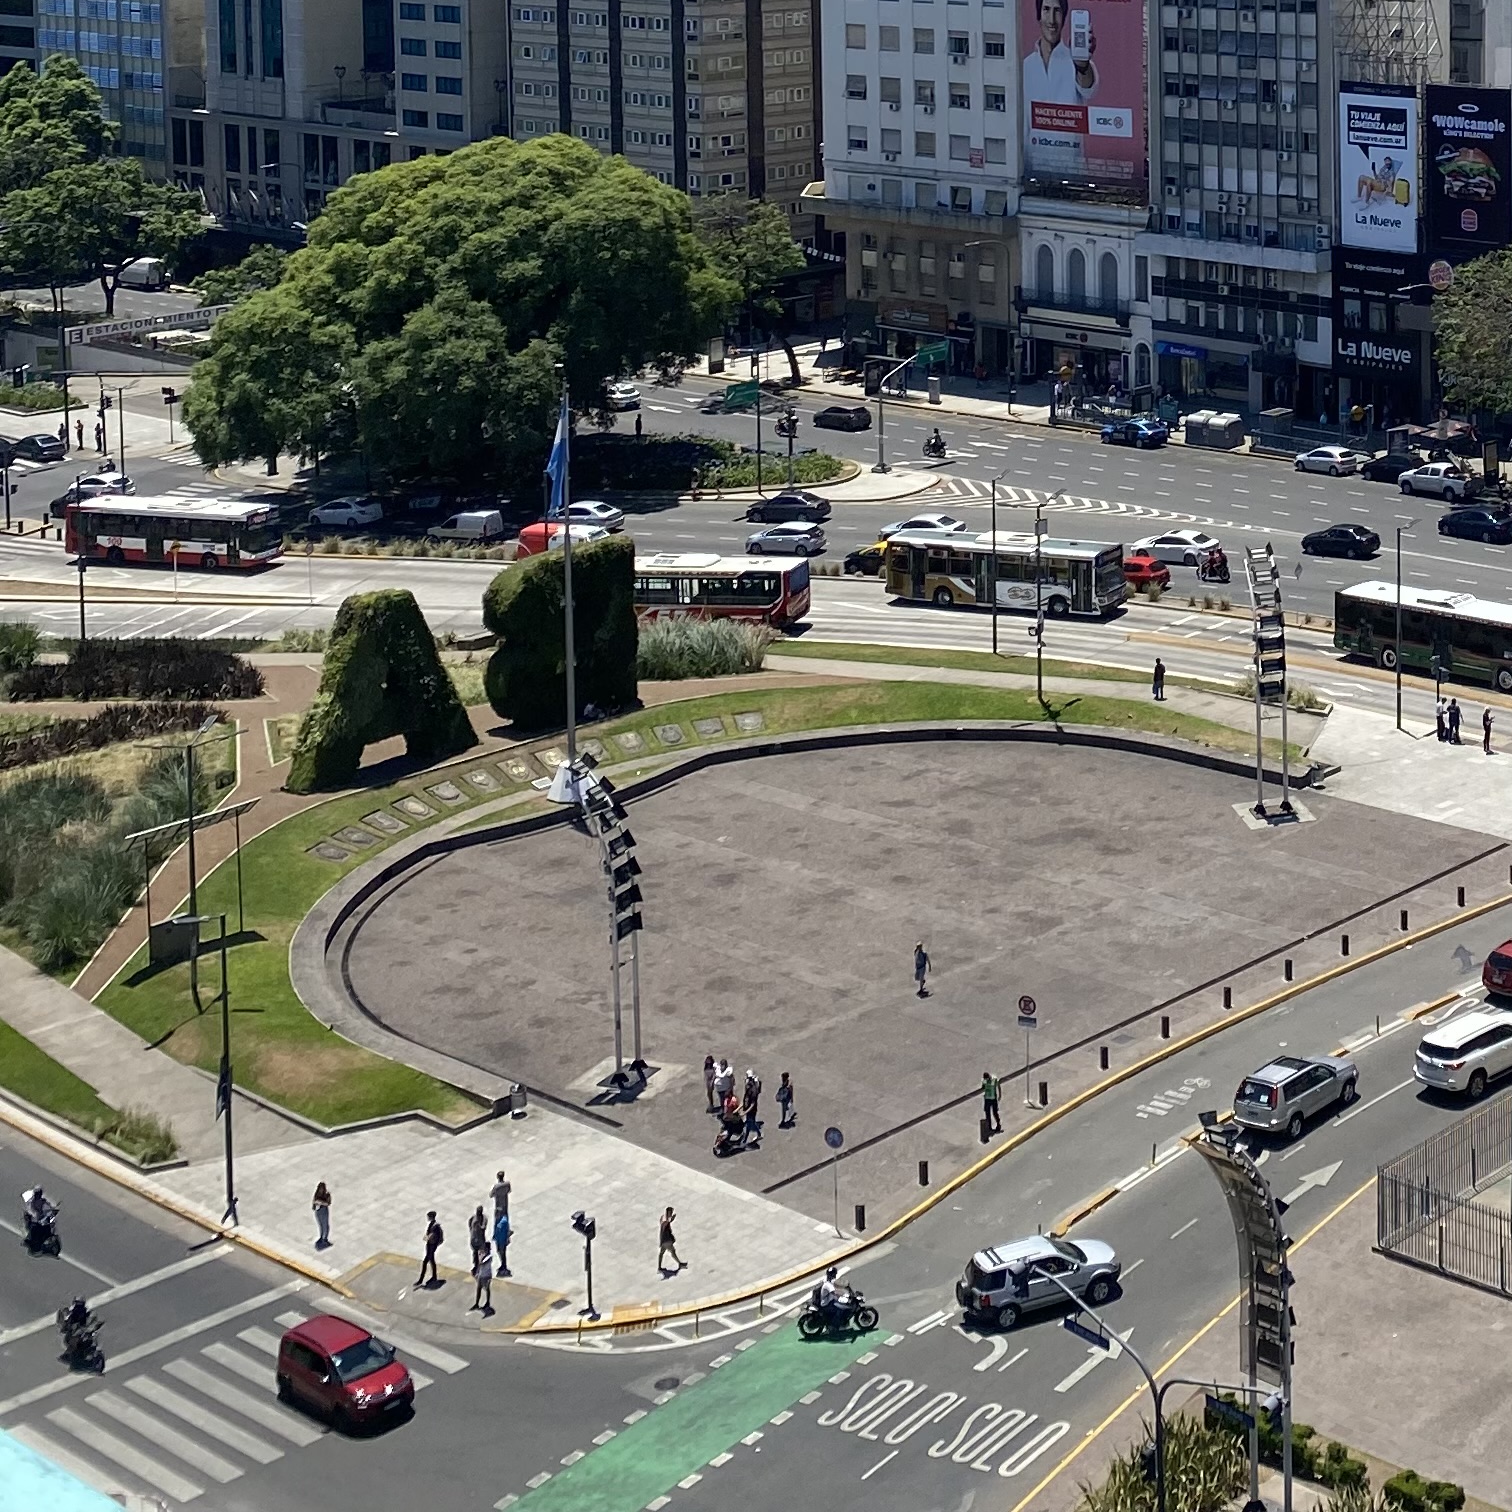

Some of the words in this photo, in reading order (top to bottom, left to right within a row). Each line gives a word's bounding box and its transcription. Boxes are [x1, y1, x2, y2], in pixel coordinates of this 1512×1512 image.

[1096, 117, 1113, 126] ICBC
[1350, 110, 1360, 120] TU
[1432, 114, 1506, 132] WOWcamole
[1038, 136, 1080, 148] icbc.com.ar
[1355, 212, 1367, 225] La
[1370, 214, 1402, 228] Nueve
[1338, 338, 1356, 356] La
[1361, 341, 1412, 364] Nueve
[1346, 358, 1403, 371] EQUIPAJES
[817, 1373, 958, 1445] SOLO
[927, 1402, 1071, 1477] SOLO
